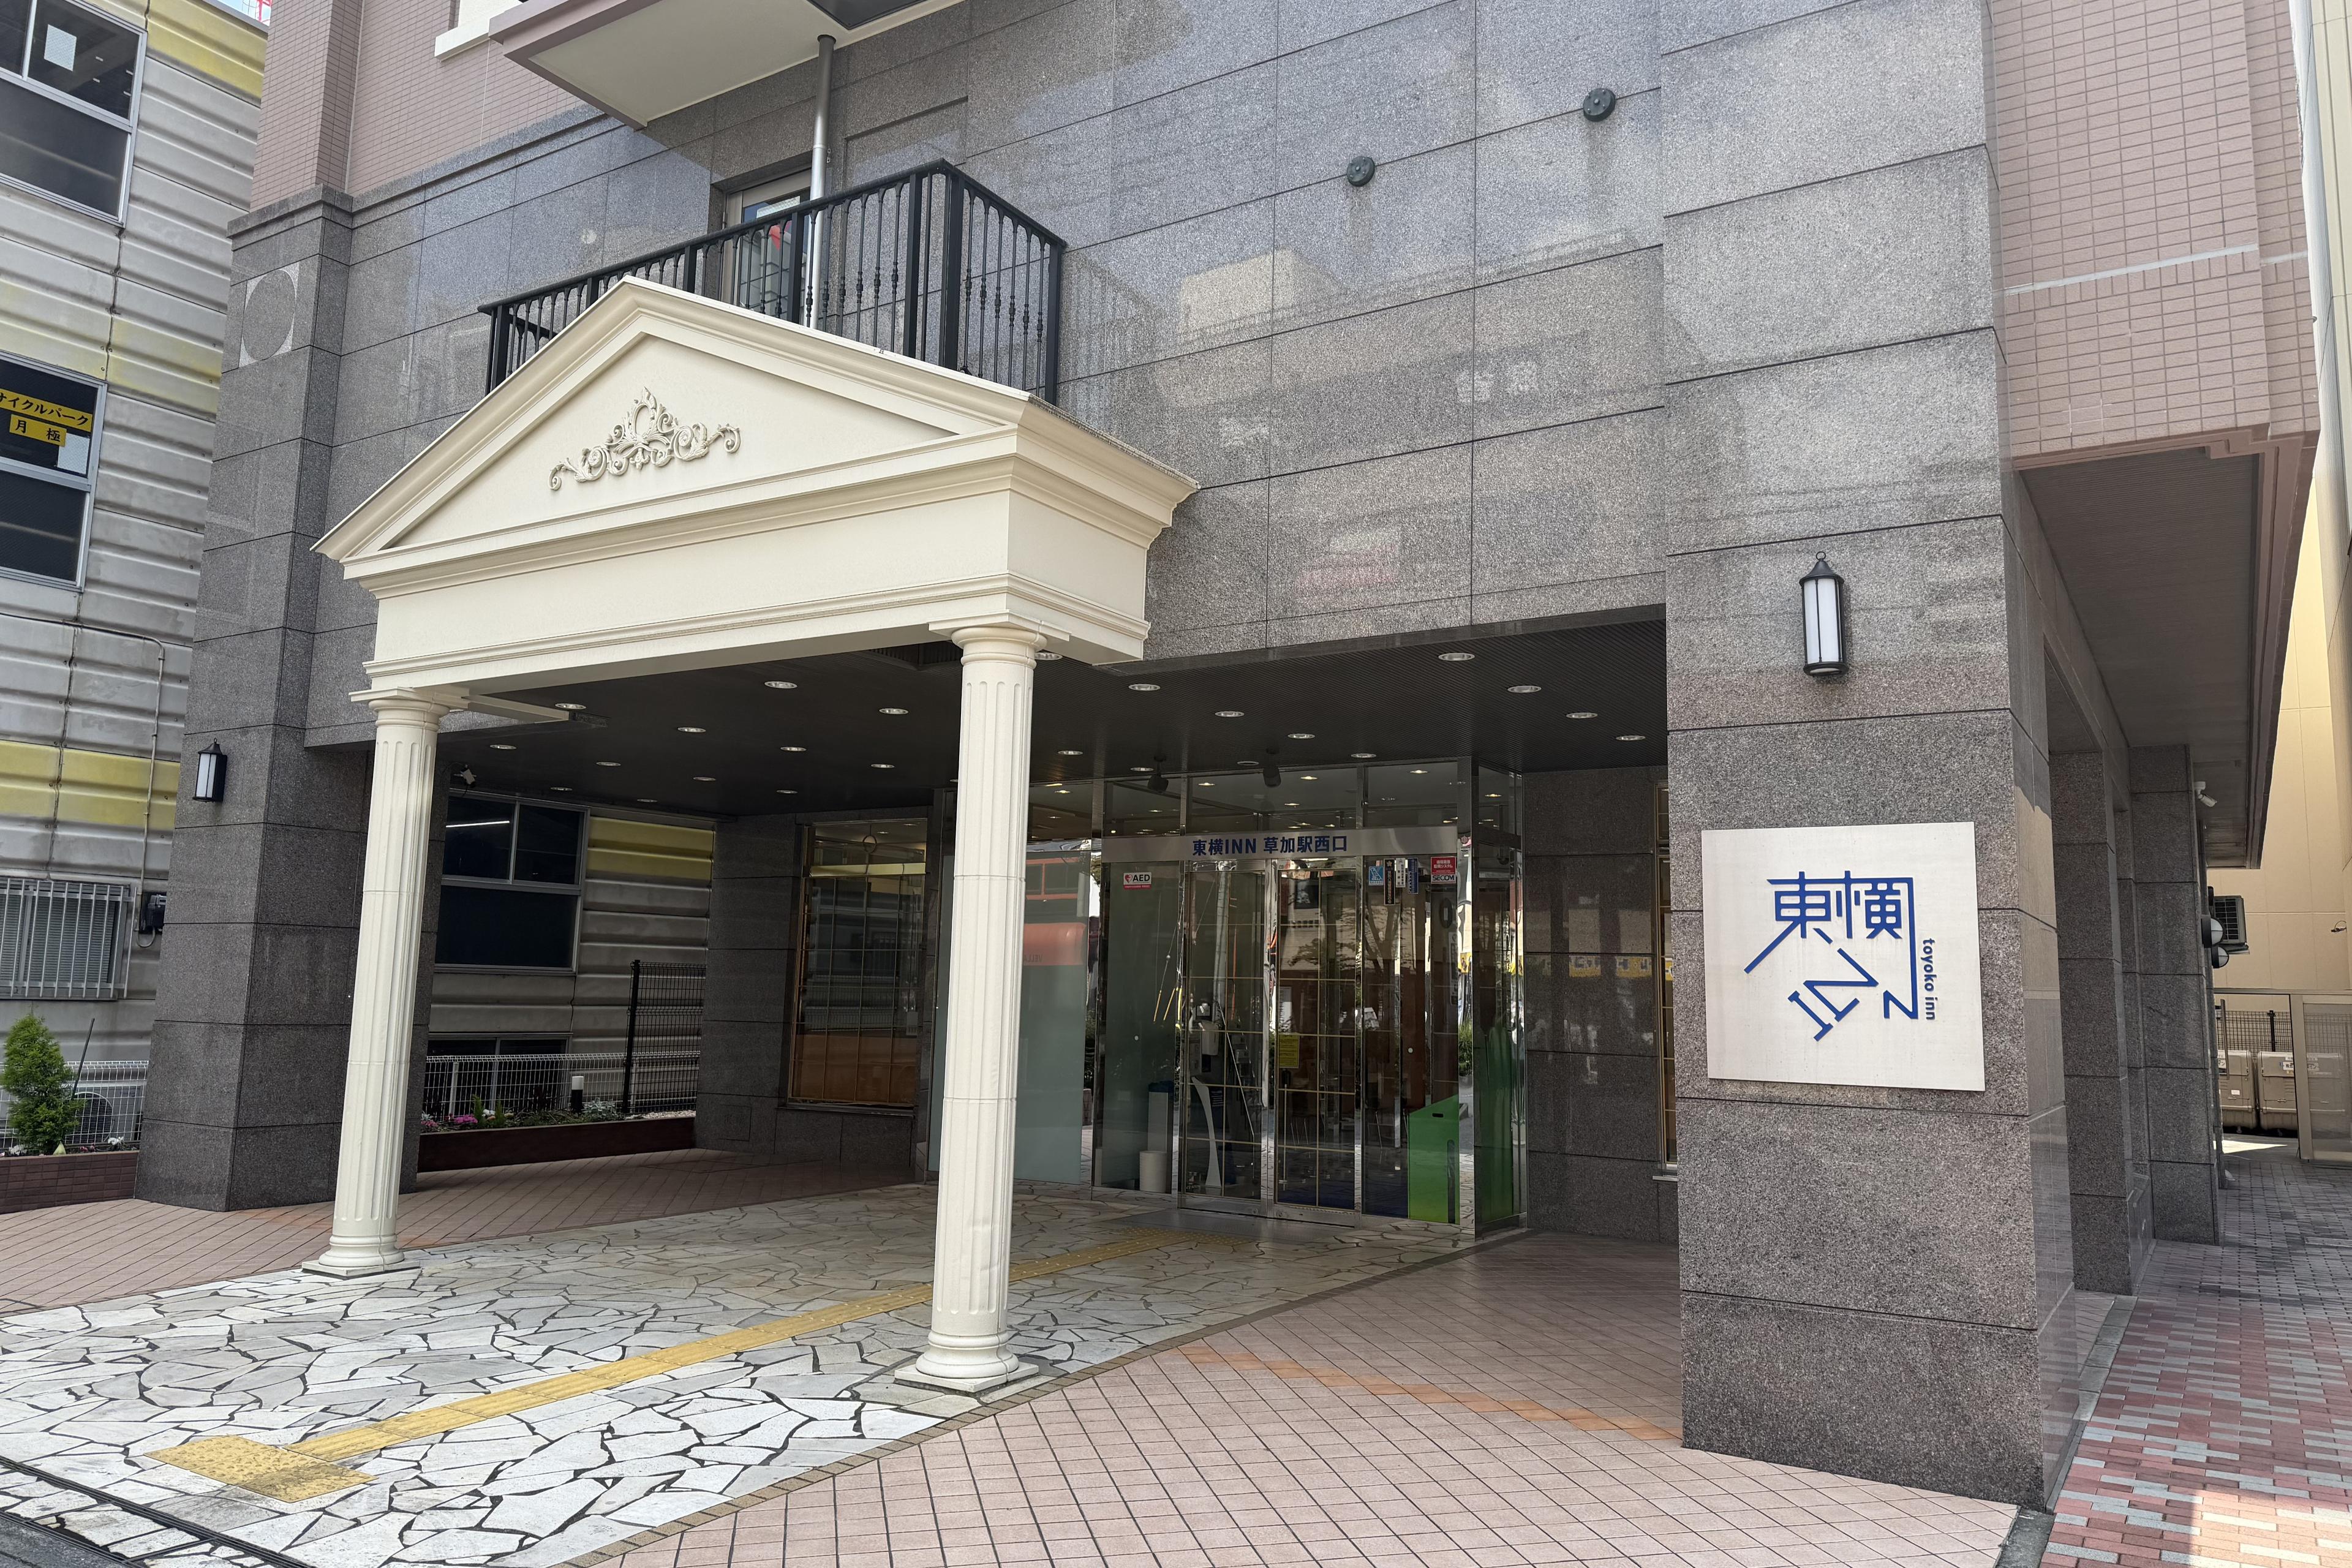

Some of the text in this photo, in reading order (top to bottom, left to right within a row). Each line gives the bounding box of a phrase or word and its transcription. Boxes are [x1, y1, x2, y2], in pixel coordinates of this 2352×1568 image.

[1193, 835, 1348, 856] 東横INN 草加駅西口
[1920, 938, 1938, 1020] toyoko inn
